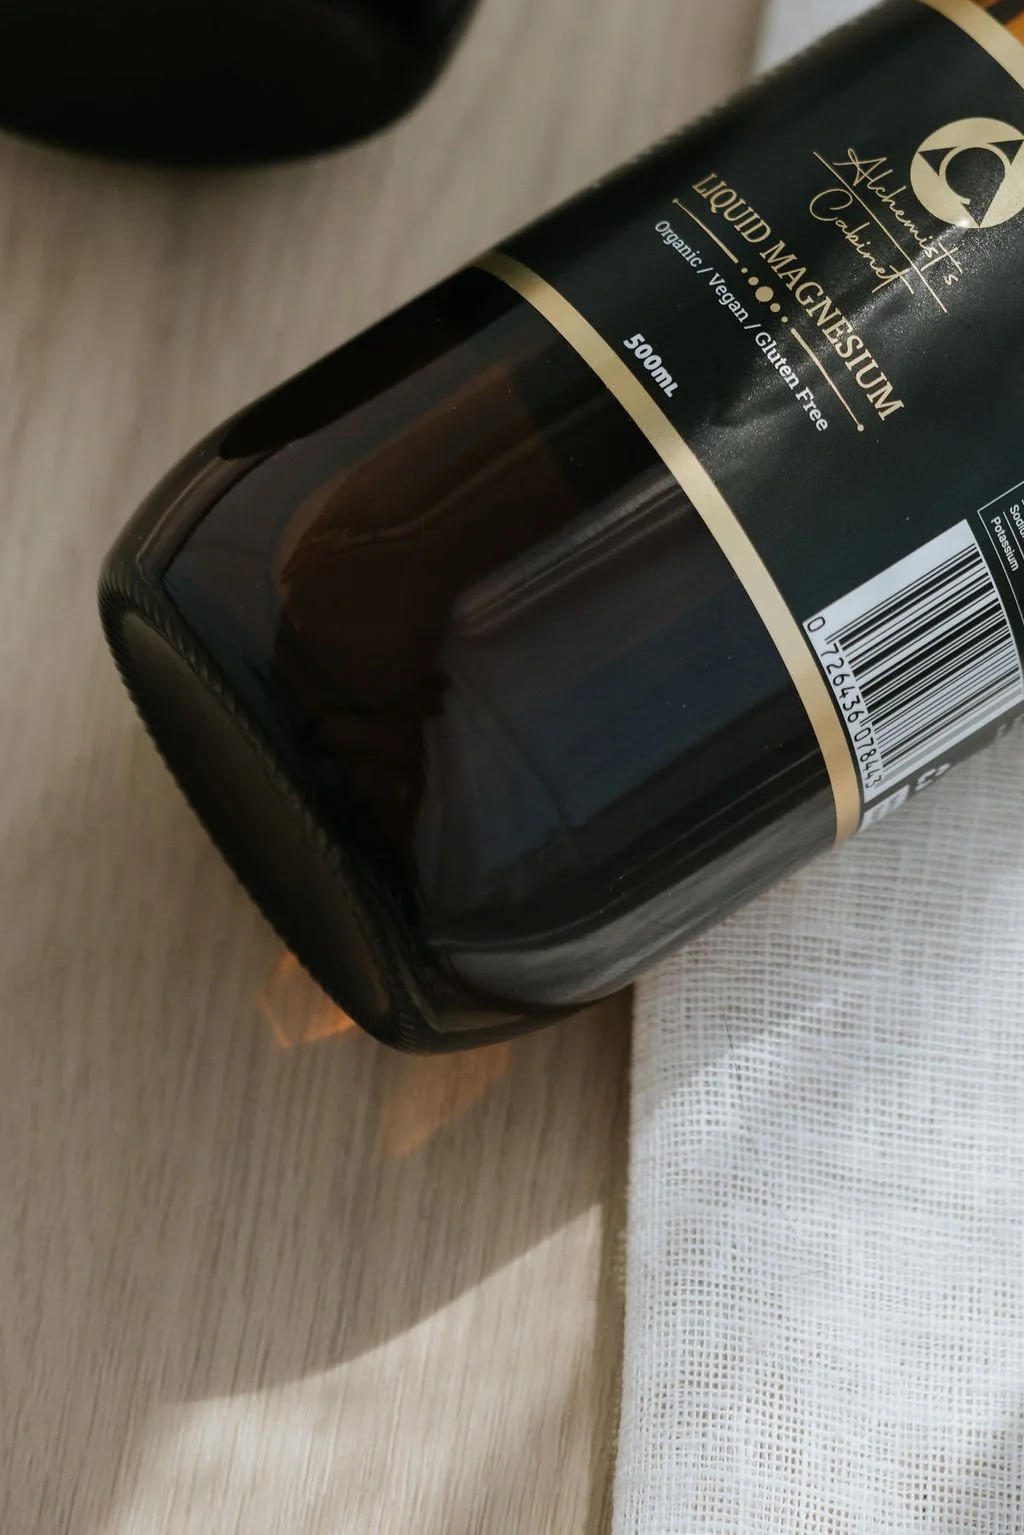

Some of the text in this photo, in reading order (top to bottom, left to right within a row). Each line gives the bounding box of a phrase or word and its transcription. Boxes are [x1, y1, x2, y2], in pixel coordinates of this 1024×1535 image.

[810, 188, 914, 294] Cabinet
[833, 148, 963, 286] Alchemist's
[623, 333, 679, 398] 500mL
[655, 221, 702, 267] Organic
[709, 273, 750, 323] Vegan
[755, 331, 800, 390] Gluten
[795, 387, 828, 431] Free
[692, 173, 904, 421] LIQUID MAGNESIUM
[991, 516, 1019, 572] Potassium
[807, 616, 882, 789] 0 726436 078443
